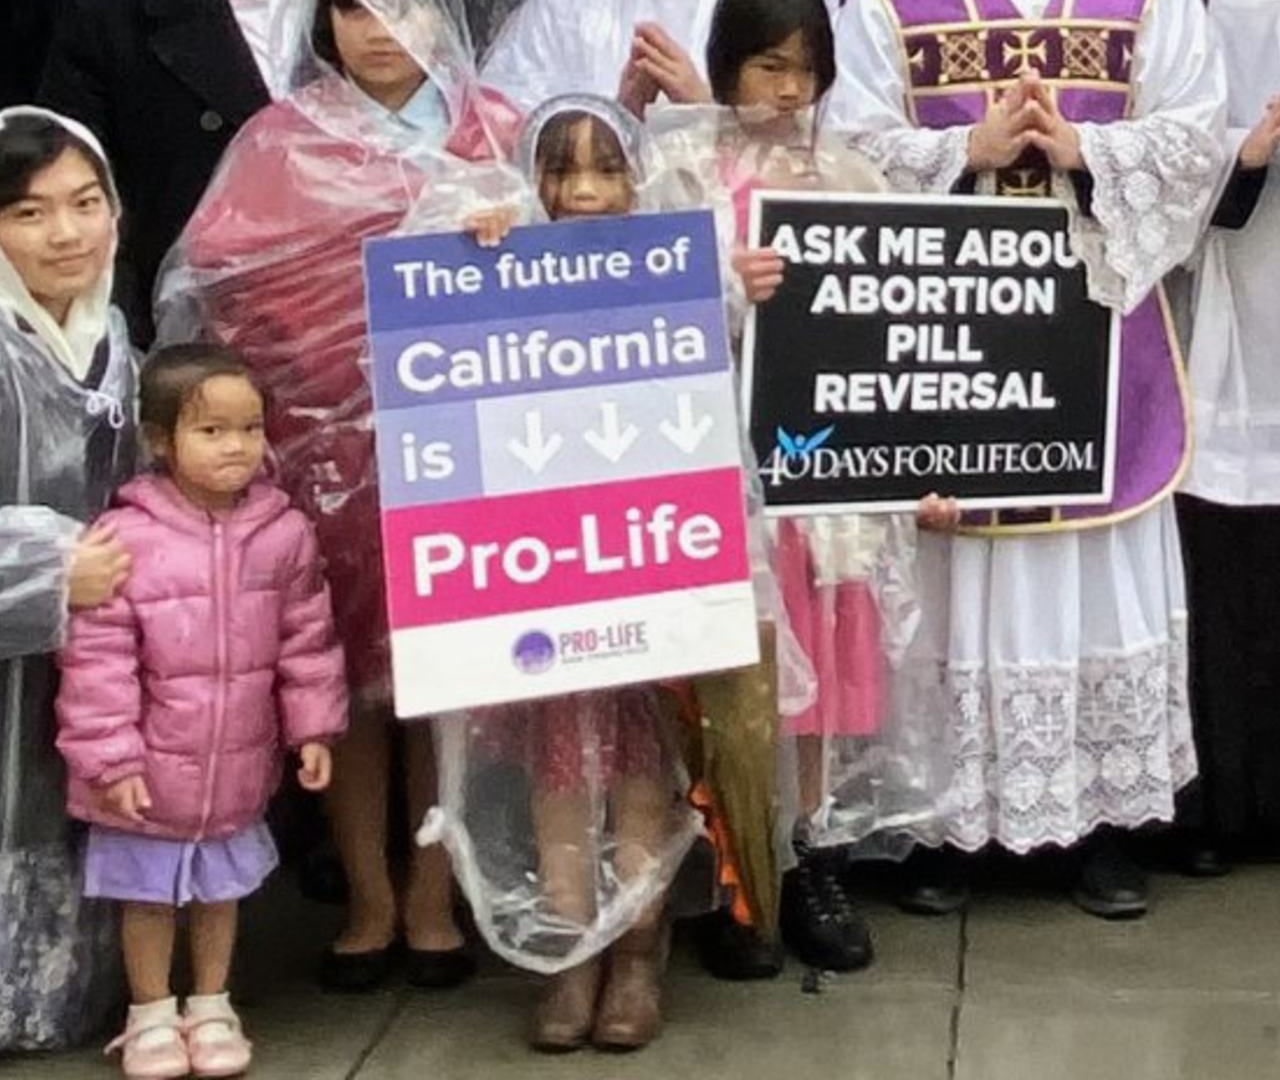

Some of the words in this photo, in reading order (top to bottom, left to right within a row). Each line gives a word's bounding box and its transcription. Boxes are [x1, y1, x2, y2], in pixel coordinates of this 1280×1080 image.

[394, 262, 482, 298] The
[496, 249, 632, 289] future
[646, 238, 691, 274] of
[769, 225, 868, 265] ASK
[878, 226, 946, 266] ME
[954, 229, 1078, 269] ABOU
[810, 274, 1057, 315] ABORTION
[397, 317, 707, 392] California
[886, 325, 983, 363] PILL
[813, 372, 1056, 413] REVERSAL
[401, 433, 455, 483] is
[413, 503, 722, 597] Pro-Life
[560, 621, 647, 655] PRO-LIFE
